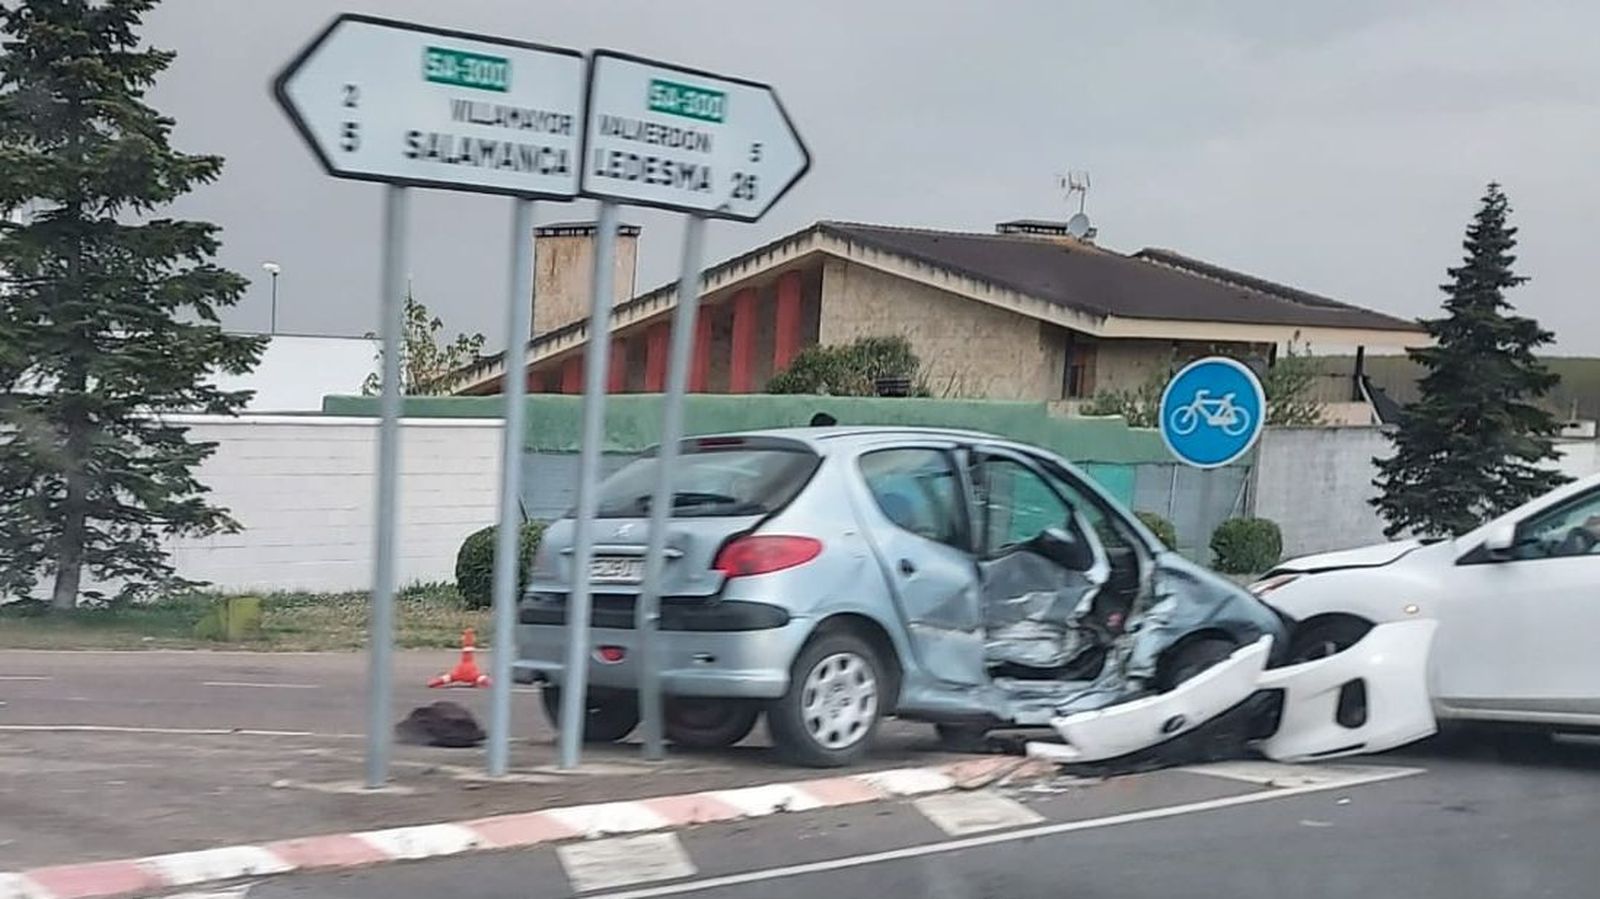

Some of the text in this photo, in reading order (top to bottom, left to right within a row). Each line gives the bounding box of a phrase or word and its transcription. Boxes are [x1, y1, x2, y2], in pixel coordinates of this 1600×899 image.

[341, 84, 572, 135] 2 VILLAMAYOR
[340, 121, 570, 175] 5 SALAMANCA
[594, 148, 711, 191] LEDESMA
[749, 142, 763, 163] 5
